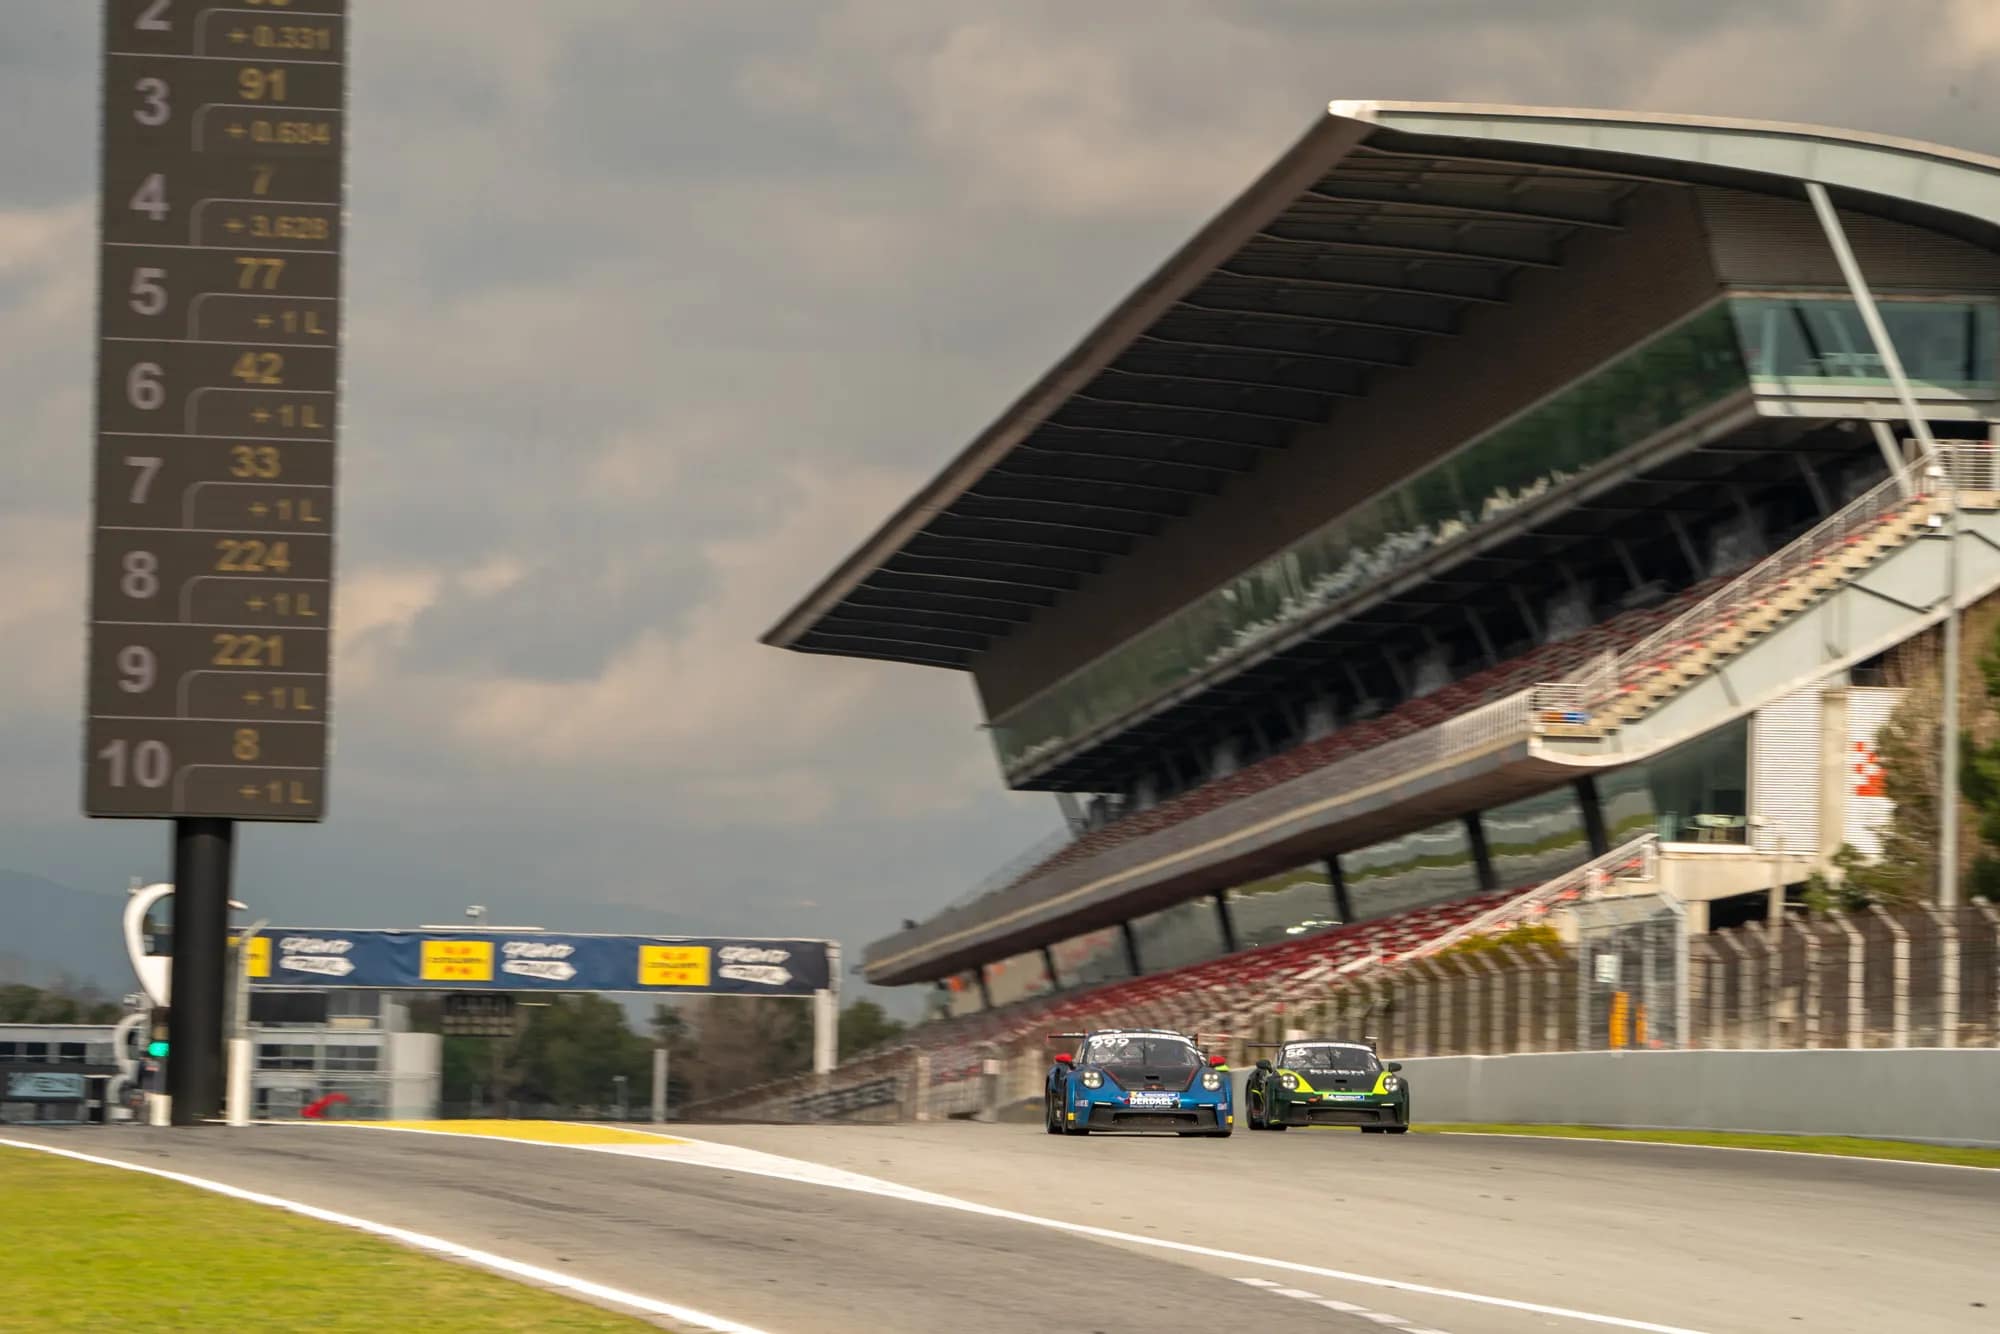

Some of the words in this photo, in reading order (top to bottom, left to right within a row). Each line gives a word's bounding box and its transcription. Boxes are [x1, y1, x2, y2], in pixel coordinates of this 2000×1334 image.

[135, 0, 172, 31] 2
[238, 68, 287, 100] 91
[133, 77, 170, 126] 3
[252, 164, 275, 195] 7
[130, 173, 169, 221] 4
[235, 257, 287, 290] 77
[128, 267, 168, 316] 5
[231, 352, 284, 384] 42
[126, 362, 166, 410] 6
[229, 445, 281, 479] 33
[123, 456, 164, 504] 7
[214, 539, 290, 573] 224
[120, 550, 160, 600] 8
[213, 634, 285, 667] 221
[117, 645, 157, 694] 9
[232, 728, 261, 761] 8
[99, 739, 171, 789] 10
[1091, 1038, 1130, 1050] 999
